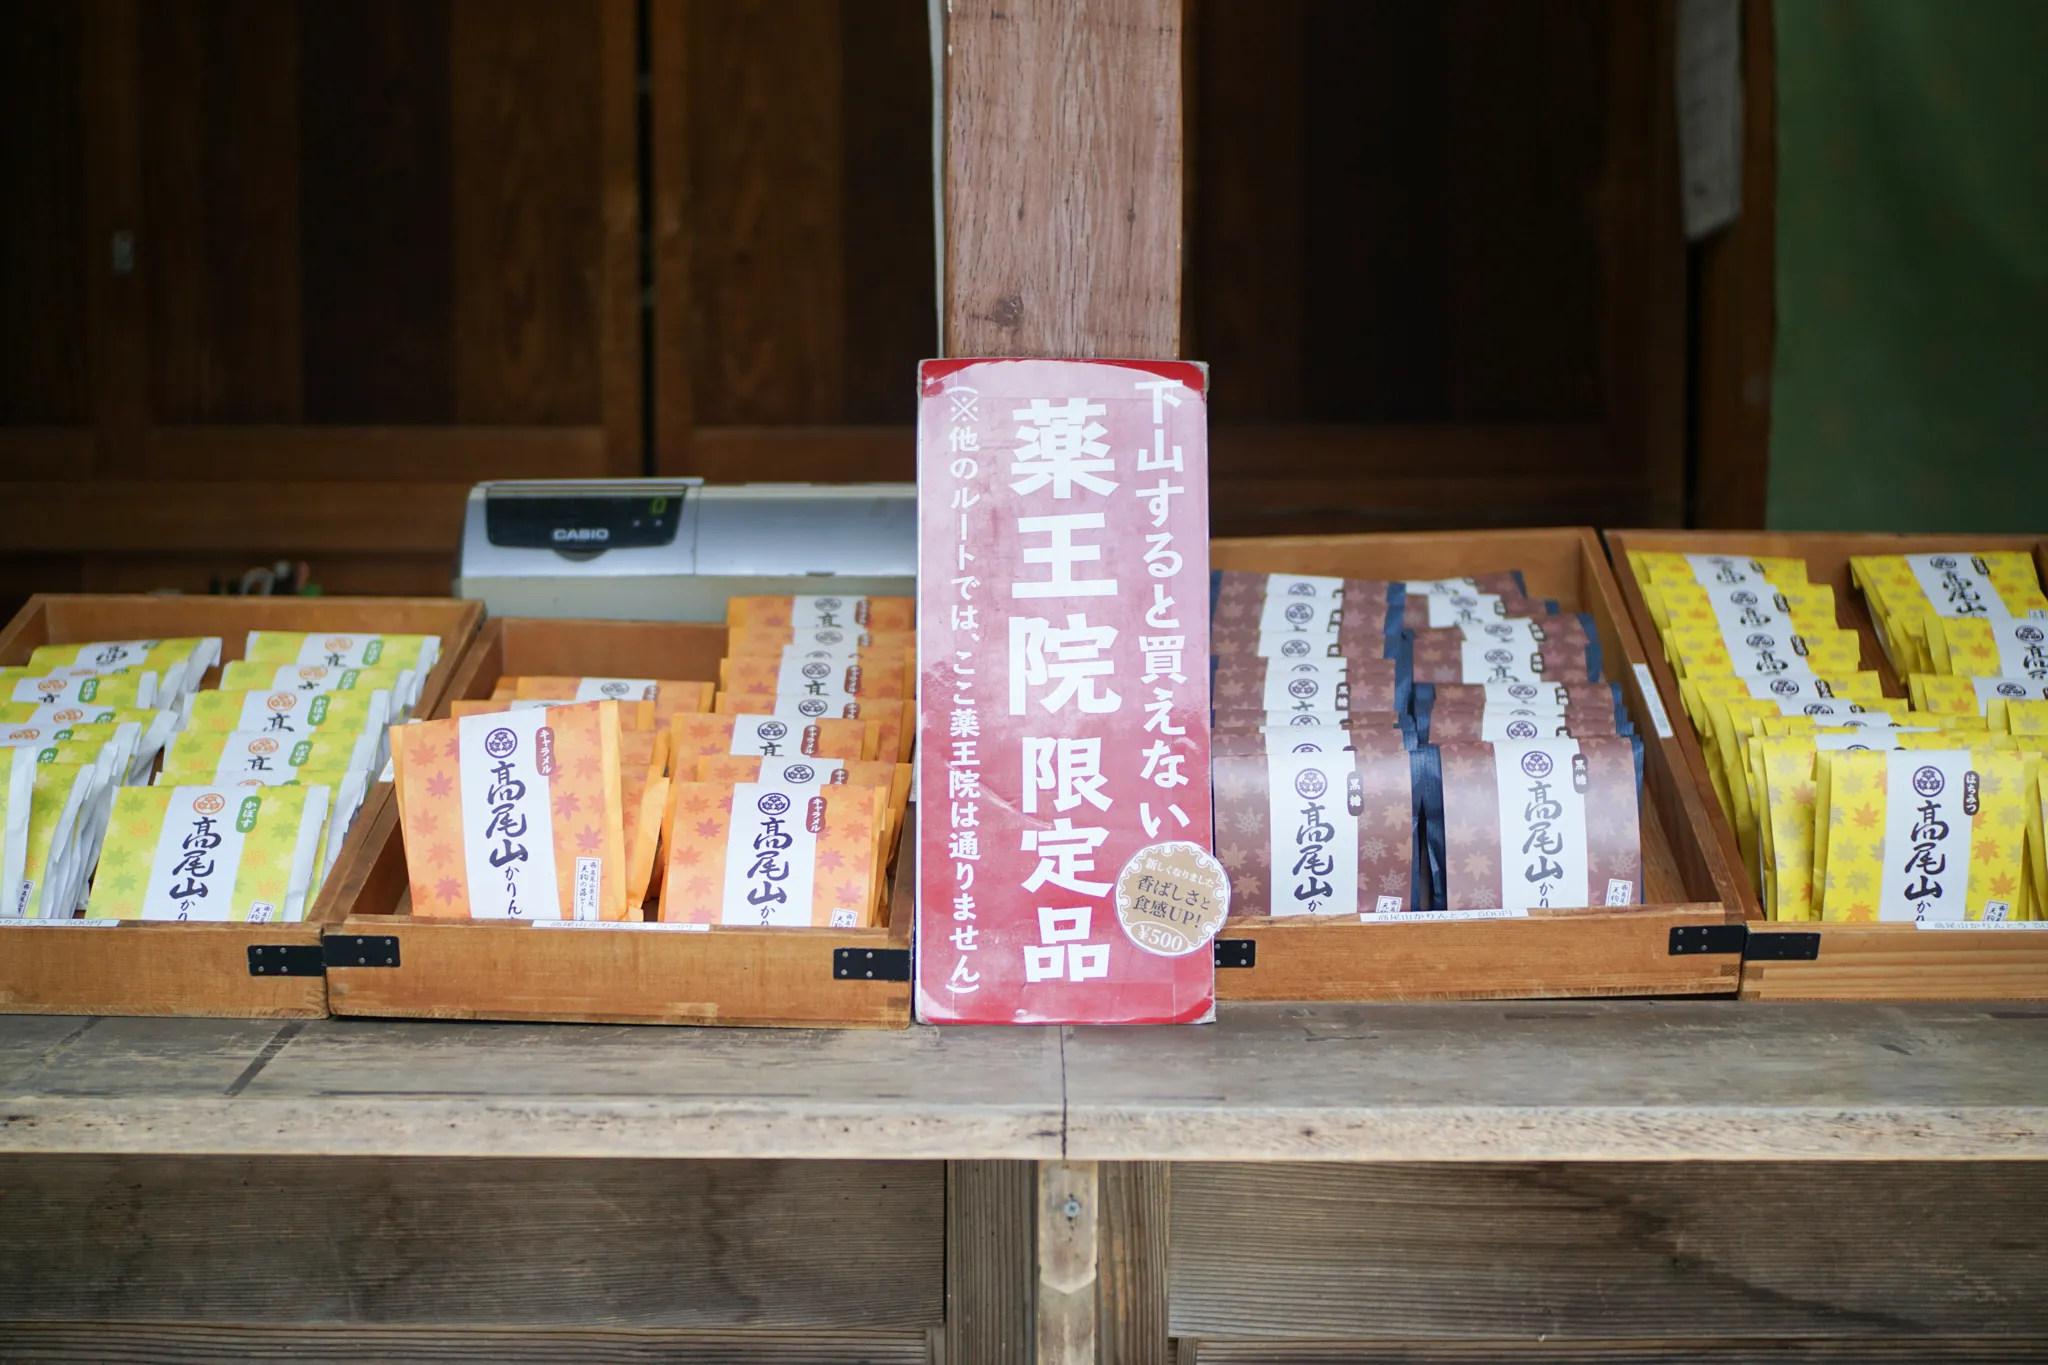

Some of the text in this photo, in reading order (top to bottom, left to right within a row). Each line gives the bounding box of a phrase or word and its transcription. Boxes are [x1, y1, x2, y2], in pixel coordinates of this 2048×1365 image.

[552, 528, 610, 541] CASIO
[1134, 379, 1190, 839] 下山すると買えない
[1008, 397, 1122, 983] 薬王院限定品
[539, 729, 553, 775] キャラメル
[1574, 759, 1588, 786] 黒糖
[1349, 778, 1363, 807] 黒糖
[1965, 774, 1978, 813] はちみつ
[240, 801, 258, 828] かぼす
[810, 797, 824, 832] キャラメル
[1144, 857, 1215, 889] 新しくなりました
[1292, 802, 1336, 915] 高尾山か
[1138, 874, 1211, 911] 香ばしさと
[1138, 924, 1183, 952] ¥500
